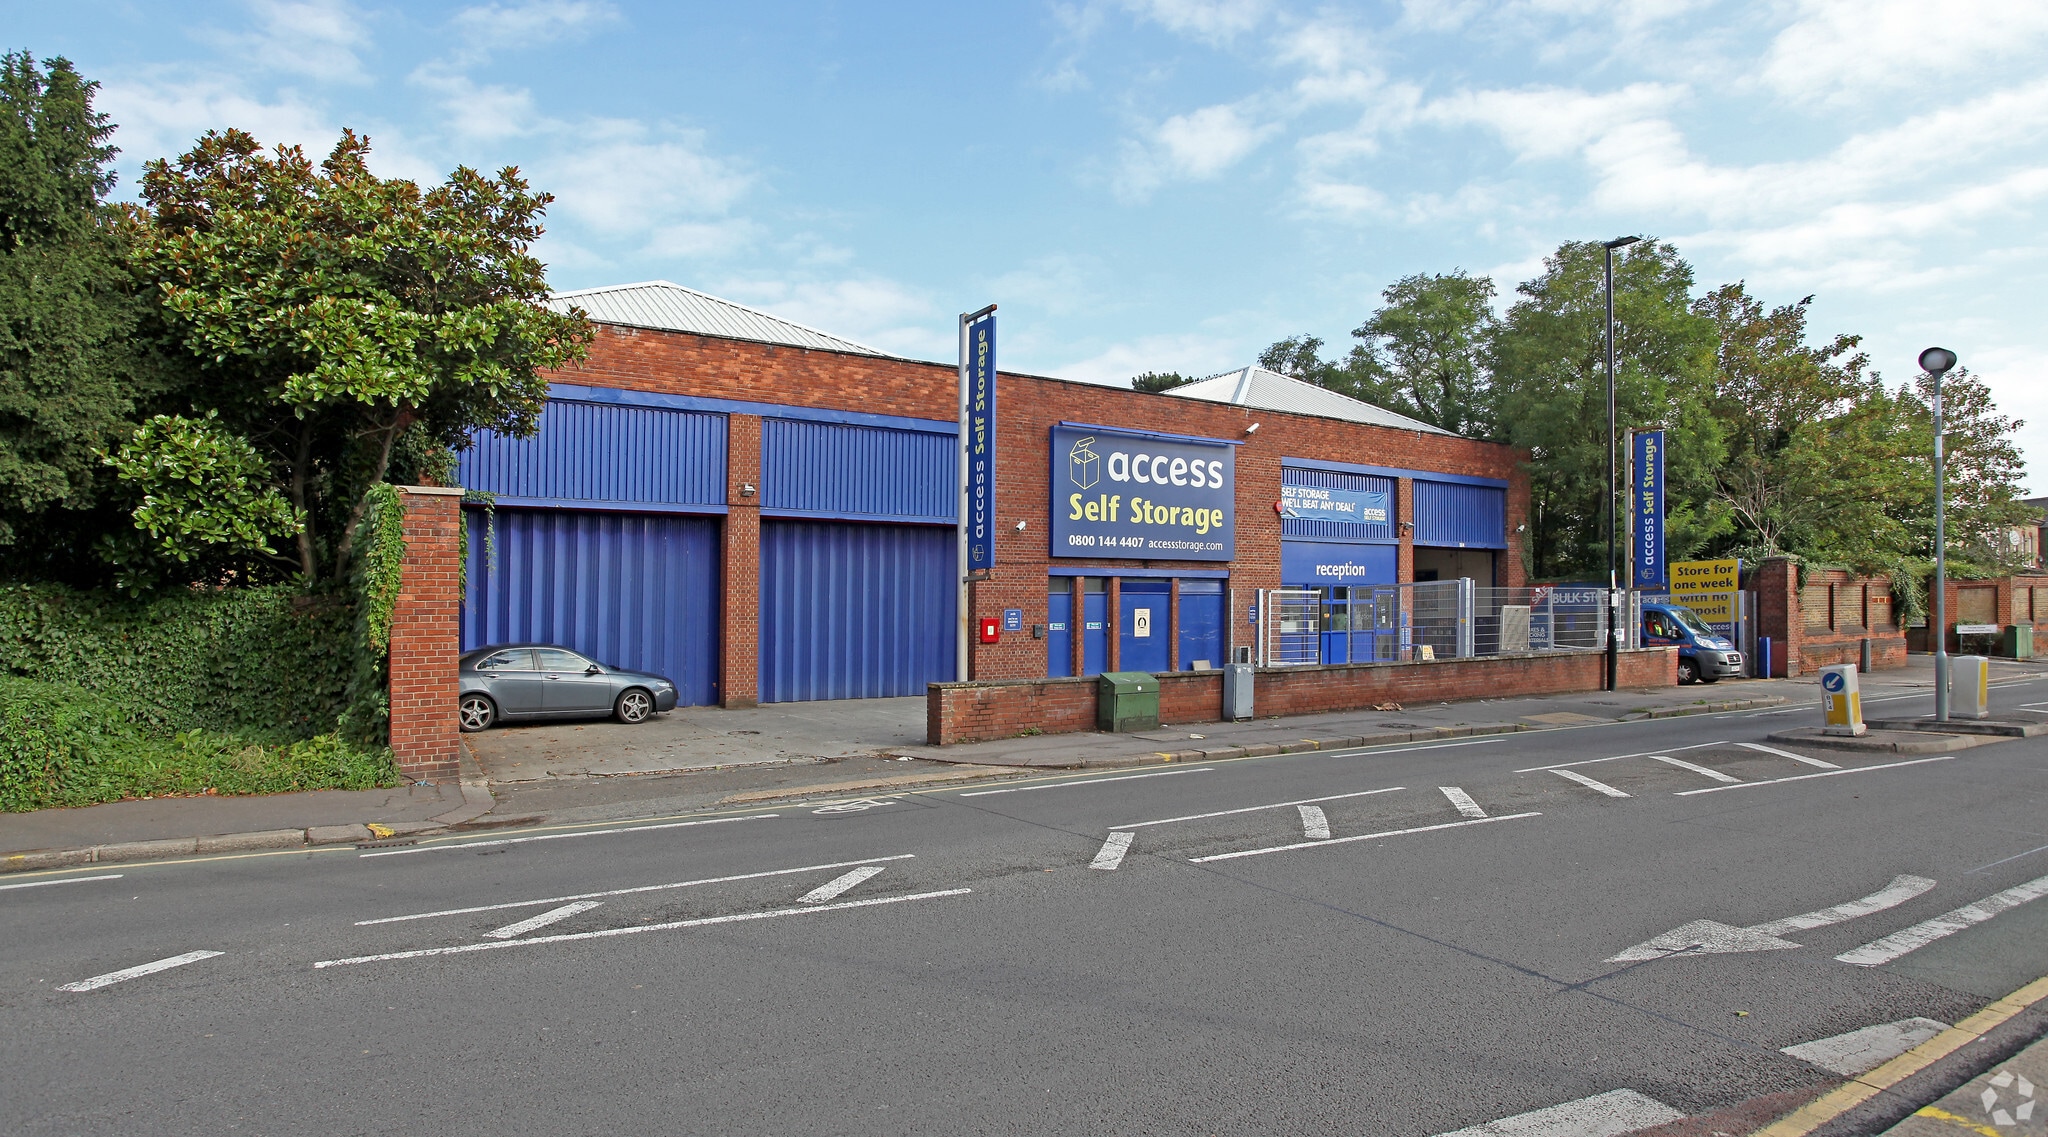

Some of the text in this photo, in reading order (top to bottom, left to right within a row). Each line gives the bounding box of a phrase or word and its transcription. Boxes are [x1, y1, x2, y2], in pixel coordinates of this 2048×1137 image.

[974, 329, 988, 539] access Self Storage
[1107, 452, 1223, 489] access
[1281, 487, 1330, 500] SELF STORAGE
[1303, 499, 1319, 509] BEAT
[1320, 502, 1335, 511] ANY
[1643, 437, 1657, 565] access Self Storage
[1069, 493, 1223, 535] Self Storage
[1363, 508, 1386, 517] access
[1068, 535, 1223, 552] 0800 144 4407 accessstorage.com
[1316, 560, 1365, 580] reception
[1677, 564, 1733, 576] Store for
[1674, 578, 1733, 590] one week
[1552, 592, 1580, 604] BULK
[1712, 594, 1728, 602] no
